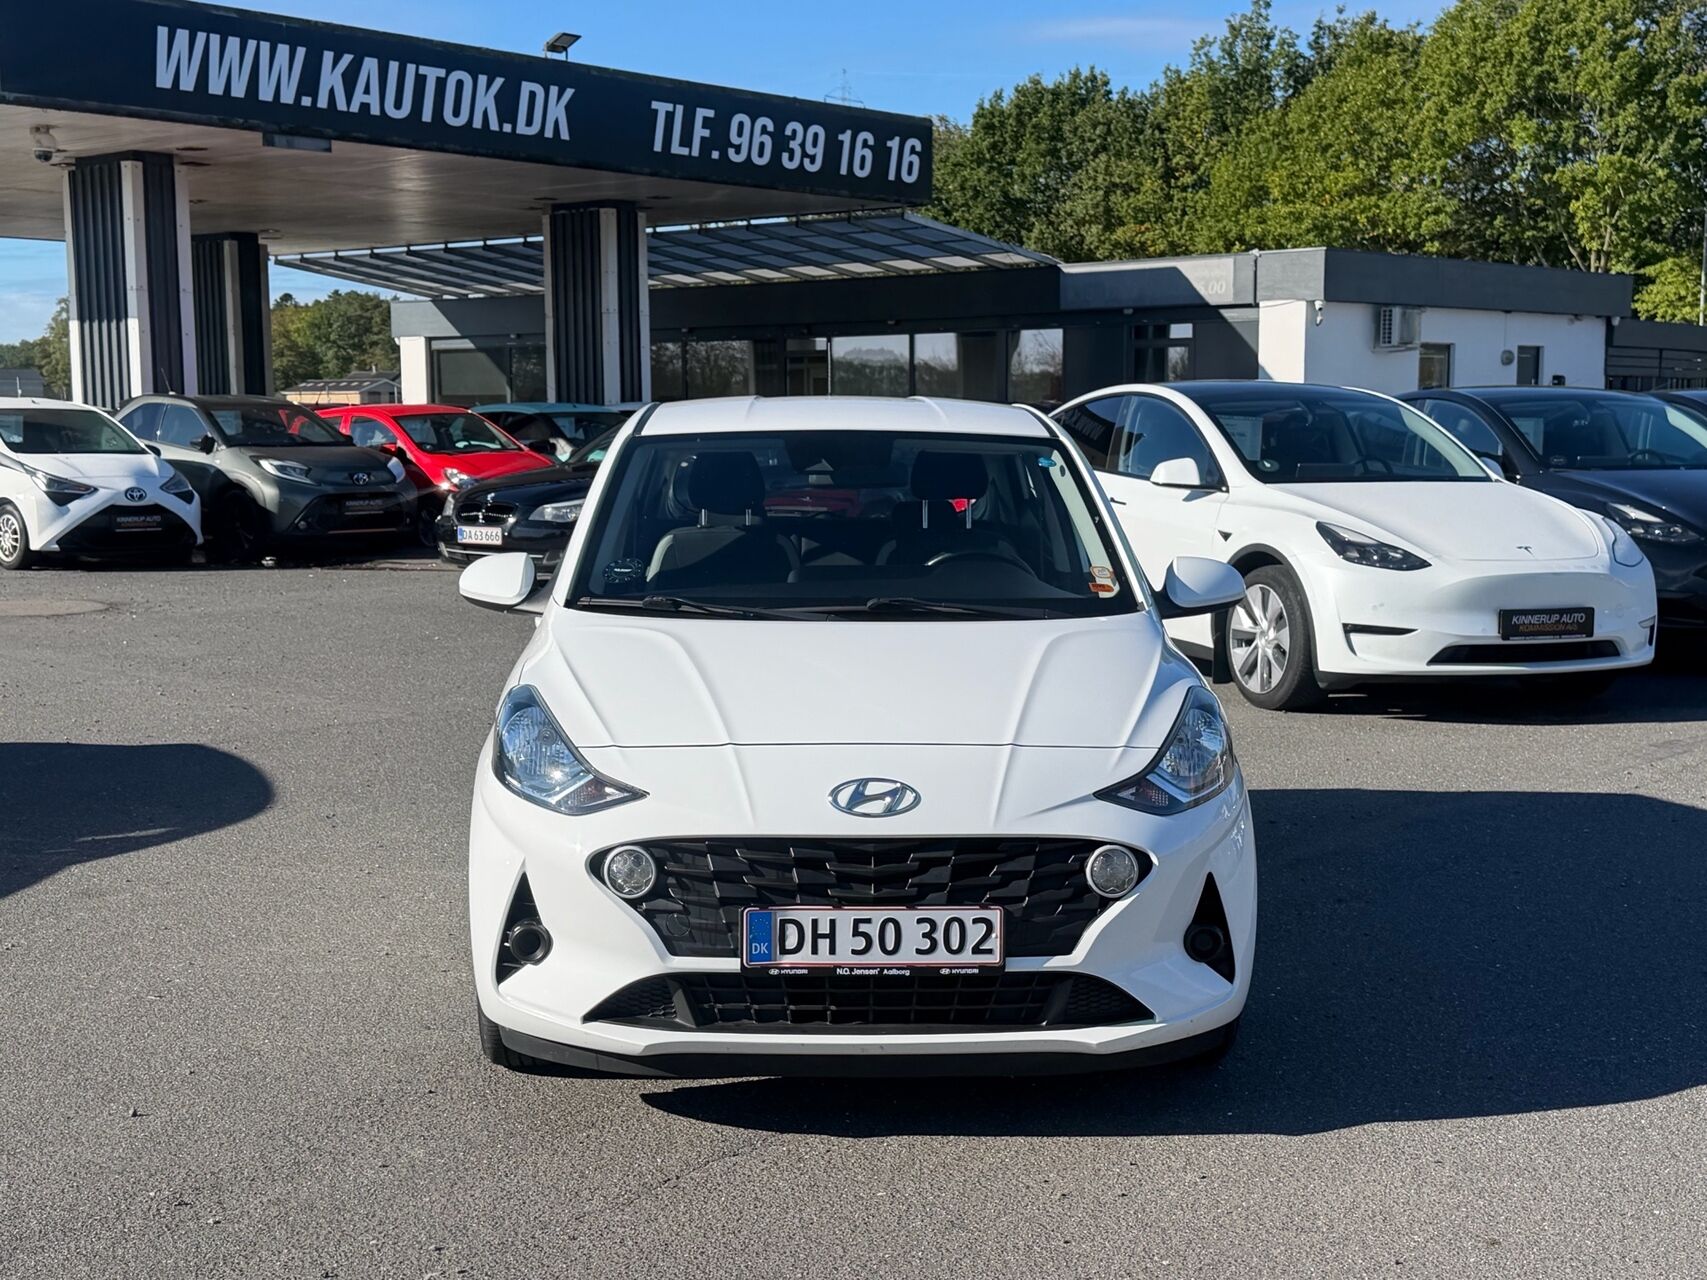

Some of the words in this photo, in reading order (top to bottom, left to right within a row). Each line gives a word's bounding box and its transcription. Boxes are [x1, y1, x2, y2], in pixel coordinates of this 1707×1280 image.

[155, 25, 576, 141] WWW.KAUTOK.DK
[651, 100, 720, 160] TLF.
[727, 103, 775, 166] 96
[781, 111, 826, 172] 39
[837, 129, 875, 178] 16
[886, 137, 922, 183] 16
[474, 530, 484, 541] 63
[485, 531, 500, 542] 666
[1512, 615, 1560, 624] KINNERUP
[1561, 613, 1585, 623] AUTO
[778, 918, 837, 956] DH
[850, 917, 902, 956] 50
[915, 916, 994, 956] 302
[752, 943, 769, 954] DK
[882, 968, 910, 977] Aalborg
